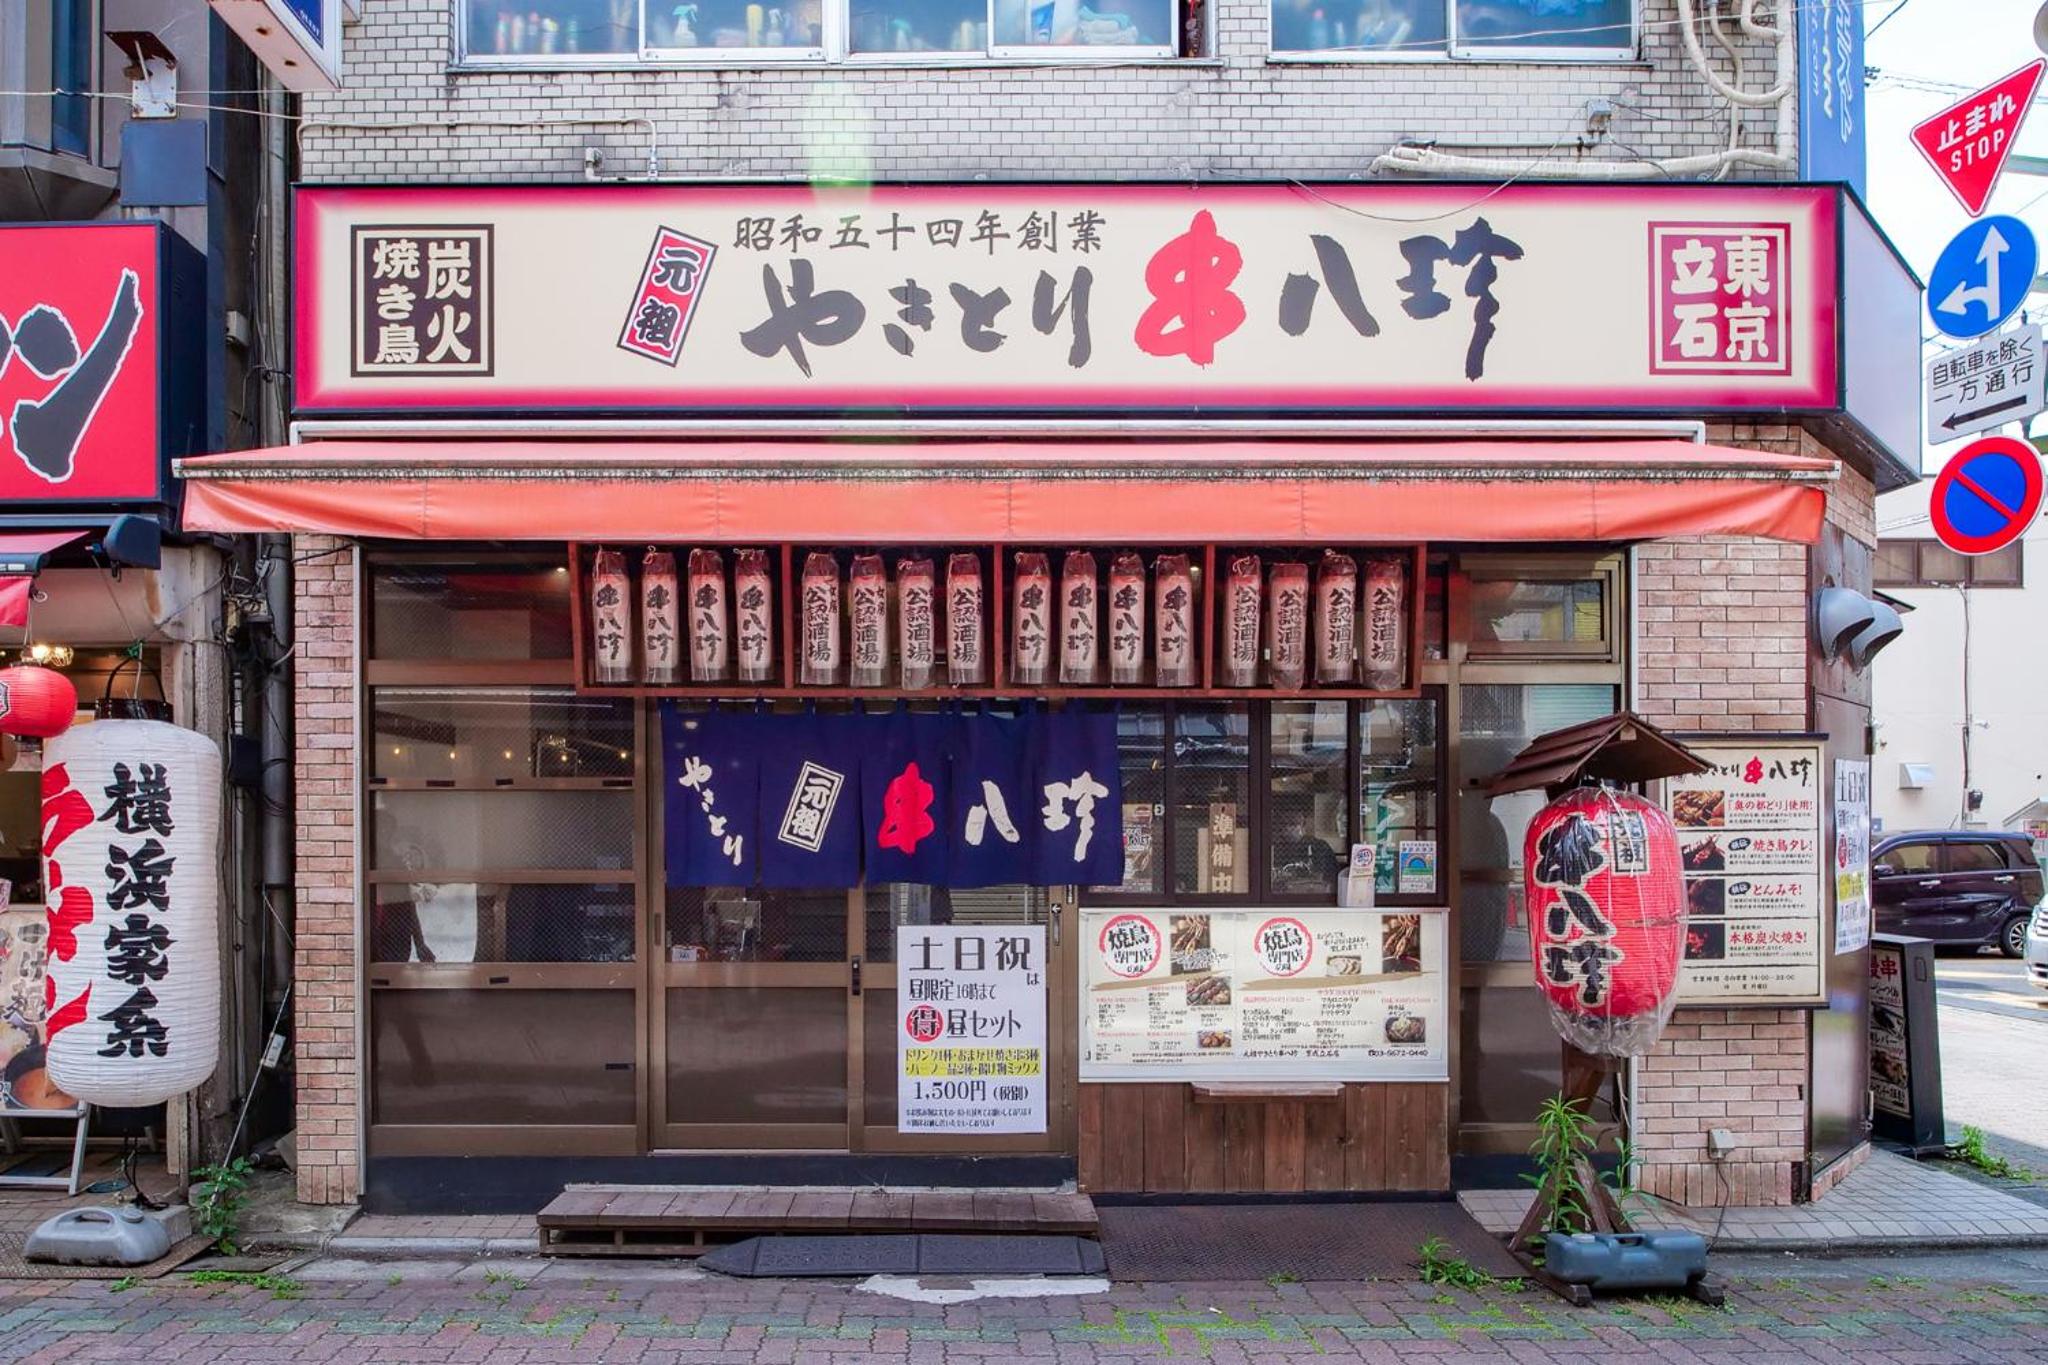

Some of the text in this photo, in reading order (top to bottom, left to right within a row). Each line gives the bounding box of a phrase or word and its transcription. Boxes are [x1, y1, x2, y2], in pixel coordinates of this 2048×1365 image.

[1937, 93, 2016, 152] 止まれ
[1950, 129, 2005, 173] STOP
[733, 210, 1106, 255] 昭和五十四年創業
[373, 238, 420, 363] 焼き鳥
[424, 239, 471, 362] 炭火
[633, 248, 700, 350] 元祖
[1670, 239, 1718, 358] 立石
[1723, 236, 1770, 361] 東京
[1933, 336, 2032, 386] 自転車を除く
[1934, 360, 2034, 403] 一方通行
[597, 584, 622, 661] 串八珍
[647, 585, 673, 662] 串八珍
[695, 584, 721, 662] 串八珍
[741, 585, 767, 663] 串八珍
[807, 587, 831, 662] 公認酒場
[855, 587, 880, 664] 公認酒場
[906, 588, 933, 664] 公認酒場
[953, 588, 978, 663] 公認酒場
[1017, 585, 1047, 661] 串八珍
[1066, 585, 1093, 661] 串八珍
[1114, 585, 1141, 661] 串八珍
[1161, 585, 1189, 663] 串八珍
[1234, 587, 1258, 662] 公認酒場
[1278, 590, 1302, 664] 公認酒場
[1328, 588, 1354, 664] 公認酒場
[1371, 588, 1397, 663] 公認酒場
[679, 756, 743, 866] やきとり
[792, 777, 832, 839] 元祖
[877, 761, 1109, 862] 串八珍
[1753, 839, 1812, 852] 焼き鳥タレ!
[1212, 813, 1233, 892] 準備中
[1753, 883, 1802, 896] とんみそ!
[97, 762, 178, 1057] 横浜家系
[1535, 814, 1622, 1004] 串八珍
[1729, 931, 1807, 945] 本格炭火焼き!
[909, 936, 1031, 971] 土日祝
[909, 1007, 1022, 1039] 得 昼セット
